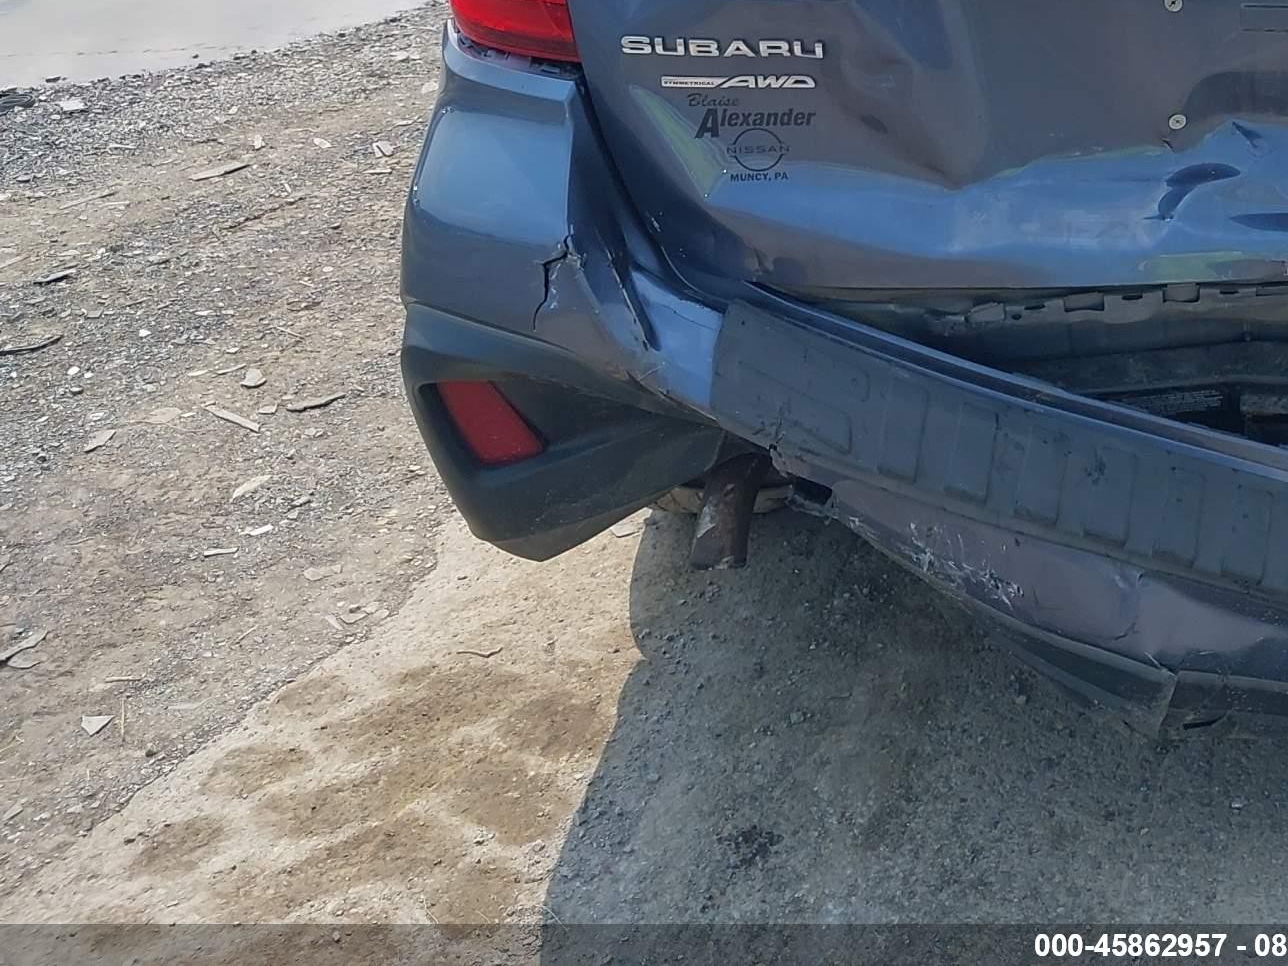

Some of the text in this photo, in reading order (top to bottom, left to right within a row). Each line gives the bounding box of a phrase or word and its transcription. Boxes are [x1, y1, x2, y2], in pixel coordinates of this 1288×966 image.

[620, 35, 824, 59] SUBARU
[718, 75, 816, 89] AWD
[687, 92, 739, 108] Blaise
[694, 107, 816, 139] Alexander
[726, 144, 790, 155] NISSAN
[730, 171, 789, 183] MUNCY, PA
